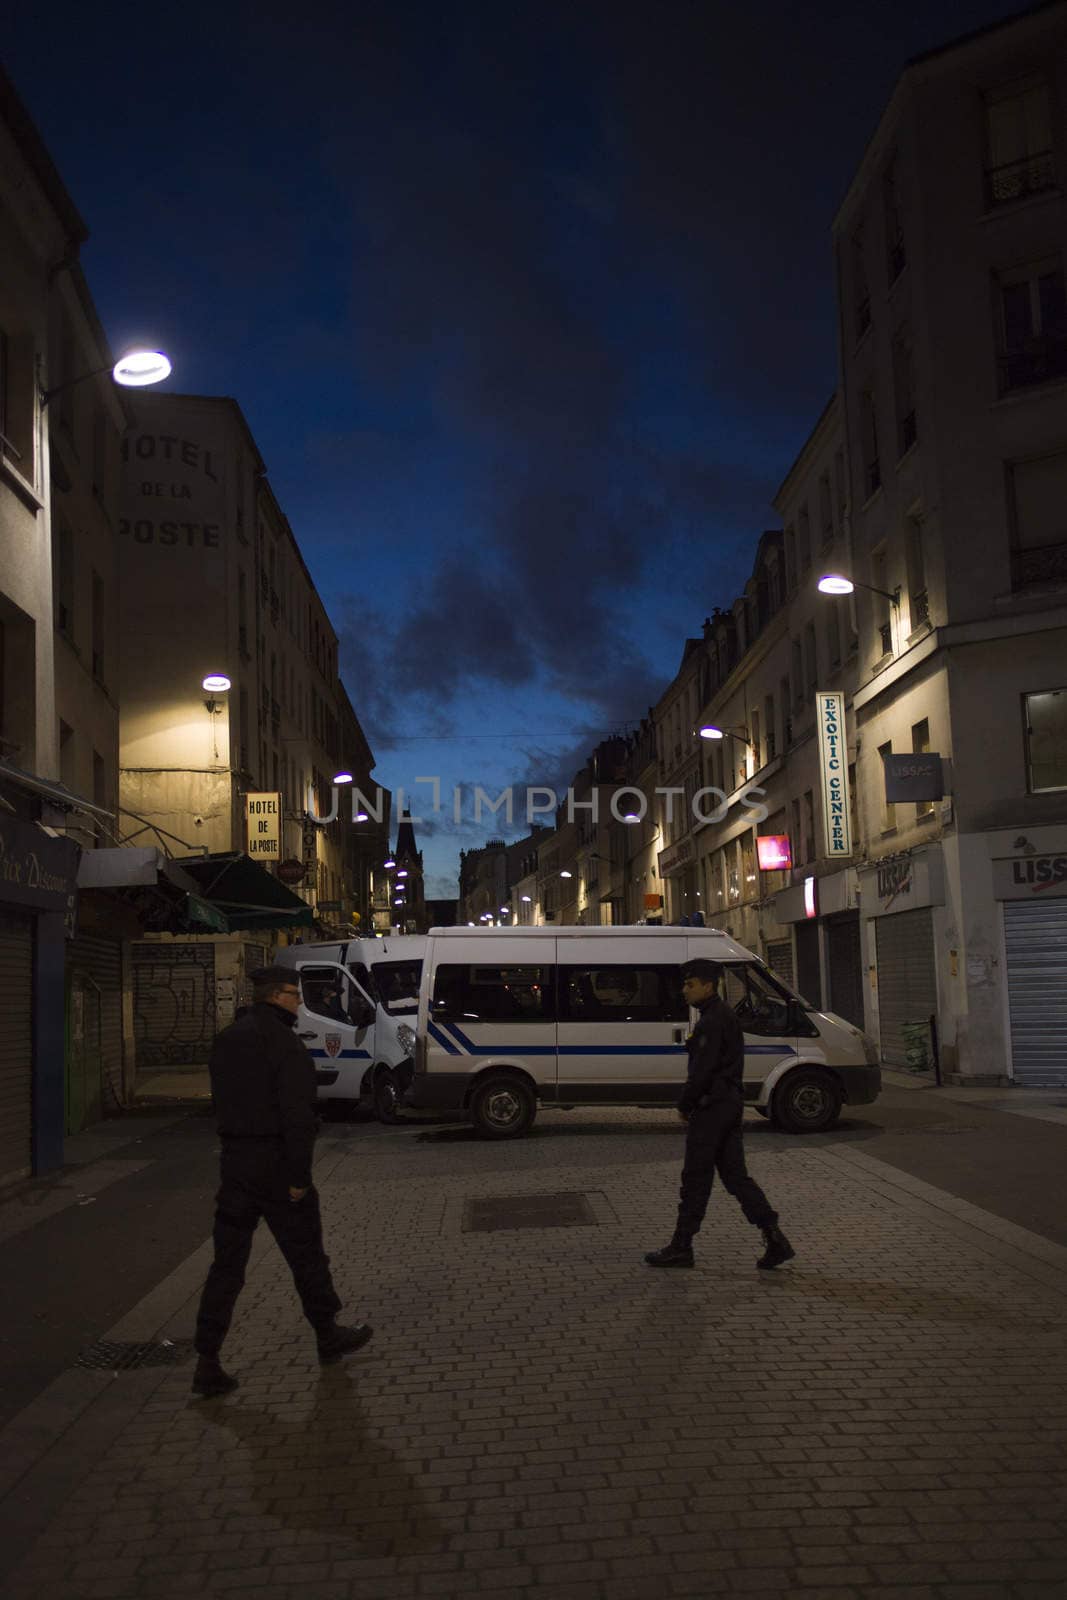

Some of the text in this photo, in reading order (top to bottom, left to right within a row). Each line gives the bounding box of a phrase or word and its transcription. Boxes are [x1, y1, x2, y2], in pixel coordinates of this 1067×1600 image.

[141, 482, 192, 498] DE LA
[824, 698, 845, 850] EXOTIC CENTER
[891, 765, 935, 777] LISSAC
[249, 801, 277, 814] HOTEL
[258, 820, 268, 833] DE
[249, 839, 277, 852] LA POSTE
[303, 816, 315, 886] HOTEL
